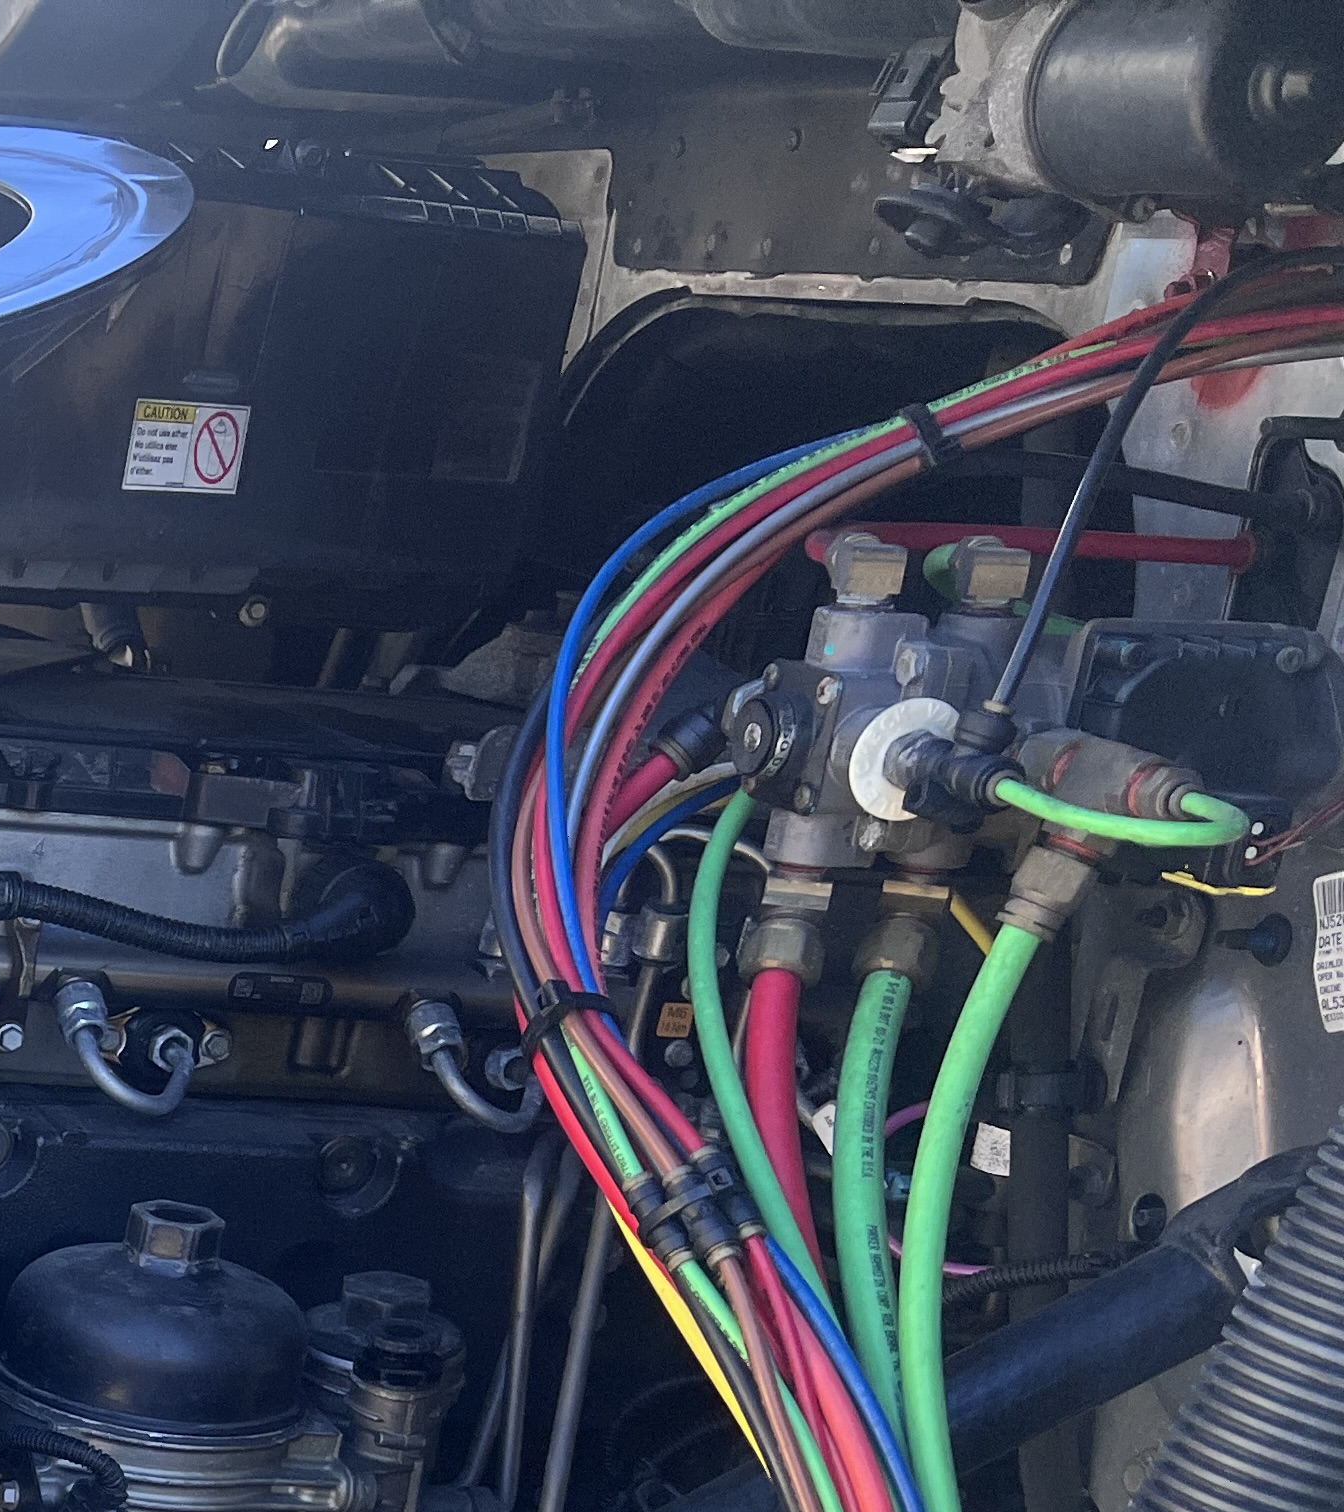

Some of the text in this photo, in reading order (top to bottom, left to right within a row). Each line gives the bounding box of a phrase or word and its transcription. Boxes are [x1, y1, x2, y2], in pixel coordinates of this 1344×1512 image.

[143, 404, 189, 420] CAUTION
[1319, 912, 1344, 931] NJ52
[1318, 931, 1343, 949] DATE
